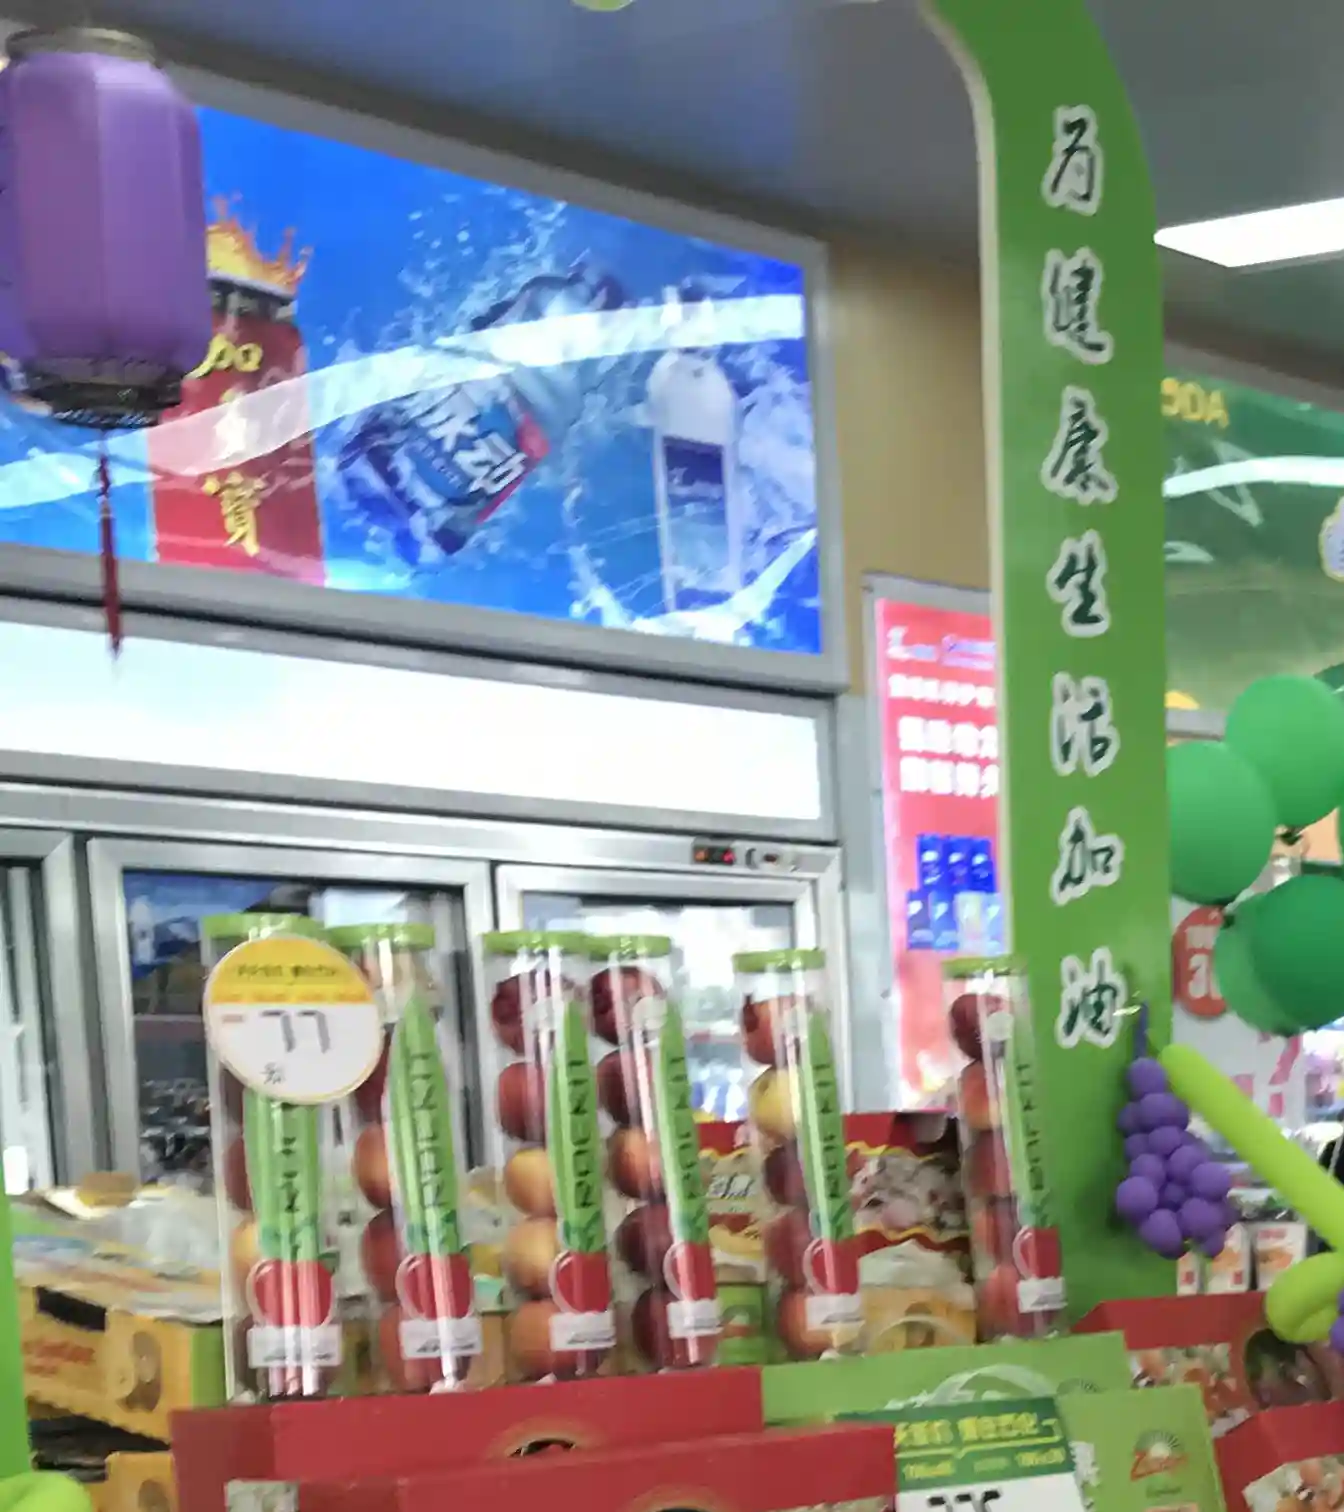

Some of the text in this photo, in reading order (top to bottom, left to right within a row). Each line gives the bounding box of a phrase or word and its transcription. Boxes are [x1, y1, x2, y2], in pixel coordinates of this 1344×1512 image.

[1047, 112, 1118, 1045] 为健康生活加油
[259, 1009, 331, 1054] 77
